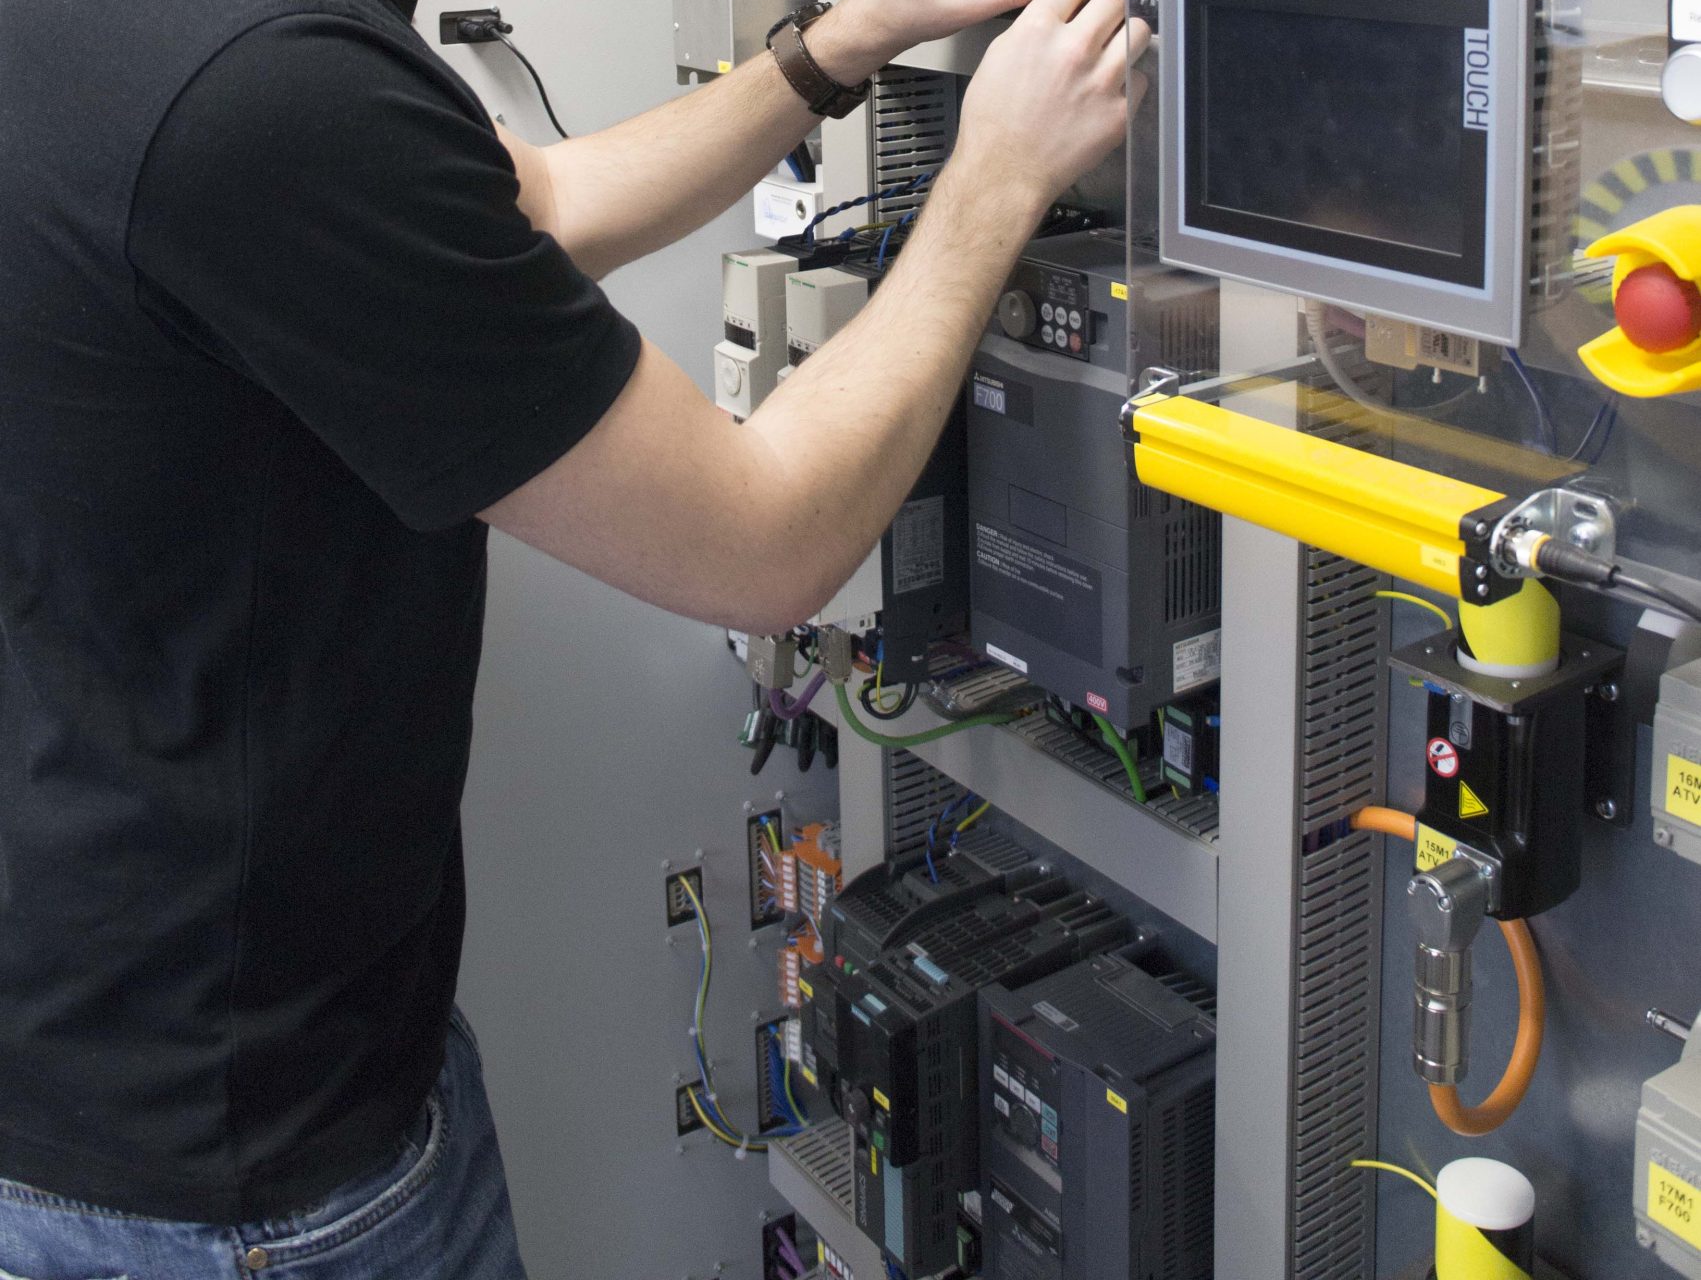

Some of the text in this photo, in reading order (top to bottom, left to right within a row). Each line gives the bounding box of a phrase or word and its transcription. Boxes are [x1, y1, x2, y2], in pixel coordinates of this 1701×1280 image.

[1466, 33, 1489, 127] TOUCH
[976, 385, 1003, 411] F700
[976, 523, 998, 537] DANGER
[977, 550, 1000, 566] CAUTION
[1673, 786, 1701, 805] ATV
[1418, 850, 1439, 867] ATV
[1425, 839, 1450, 859] 15M1
[1660, 1180, 1693, 1209] 17M1
[1659, 1194, 1691, 1223] F700
